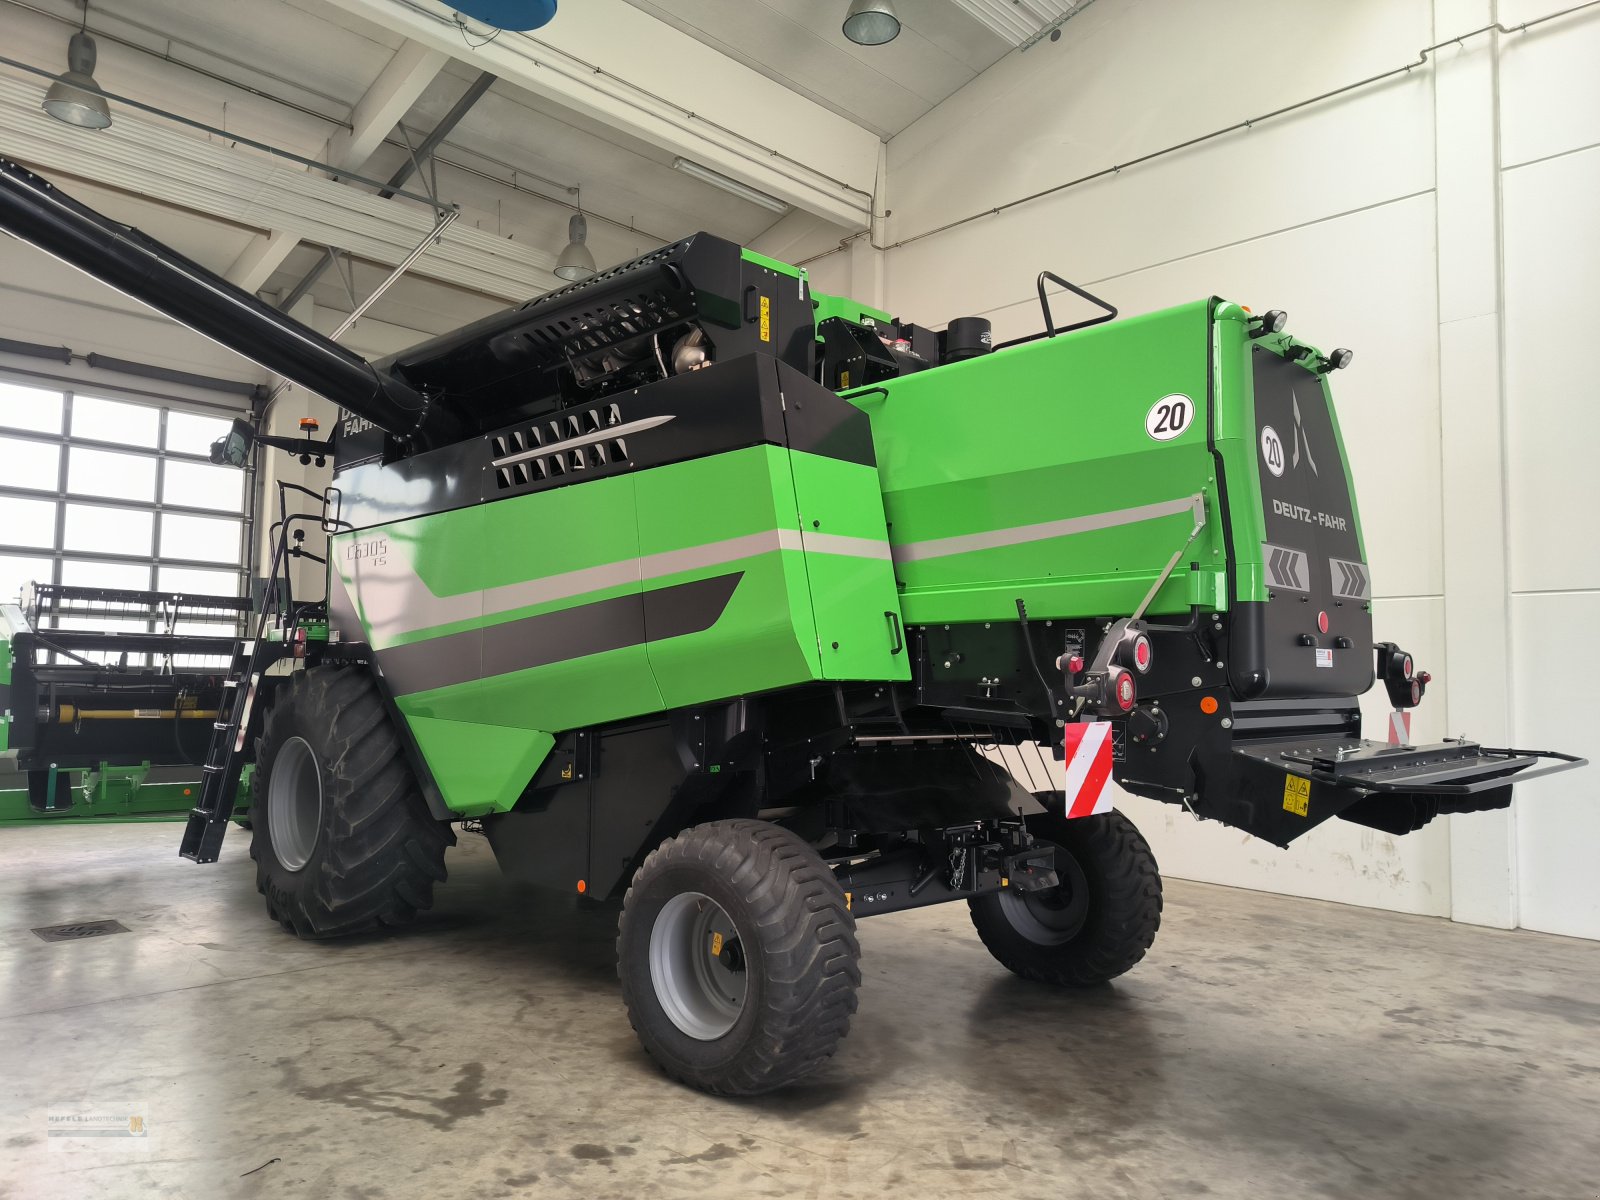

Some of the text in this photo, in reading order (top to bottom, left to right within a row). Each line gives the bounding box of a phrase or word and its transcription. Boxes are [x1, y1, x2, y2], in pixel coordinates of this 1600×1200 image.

[1153, 401, 1186, 434] 20
[1265, 435, 1282, 469] 20
[346, 538, 387, 561] C6305
